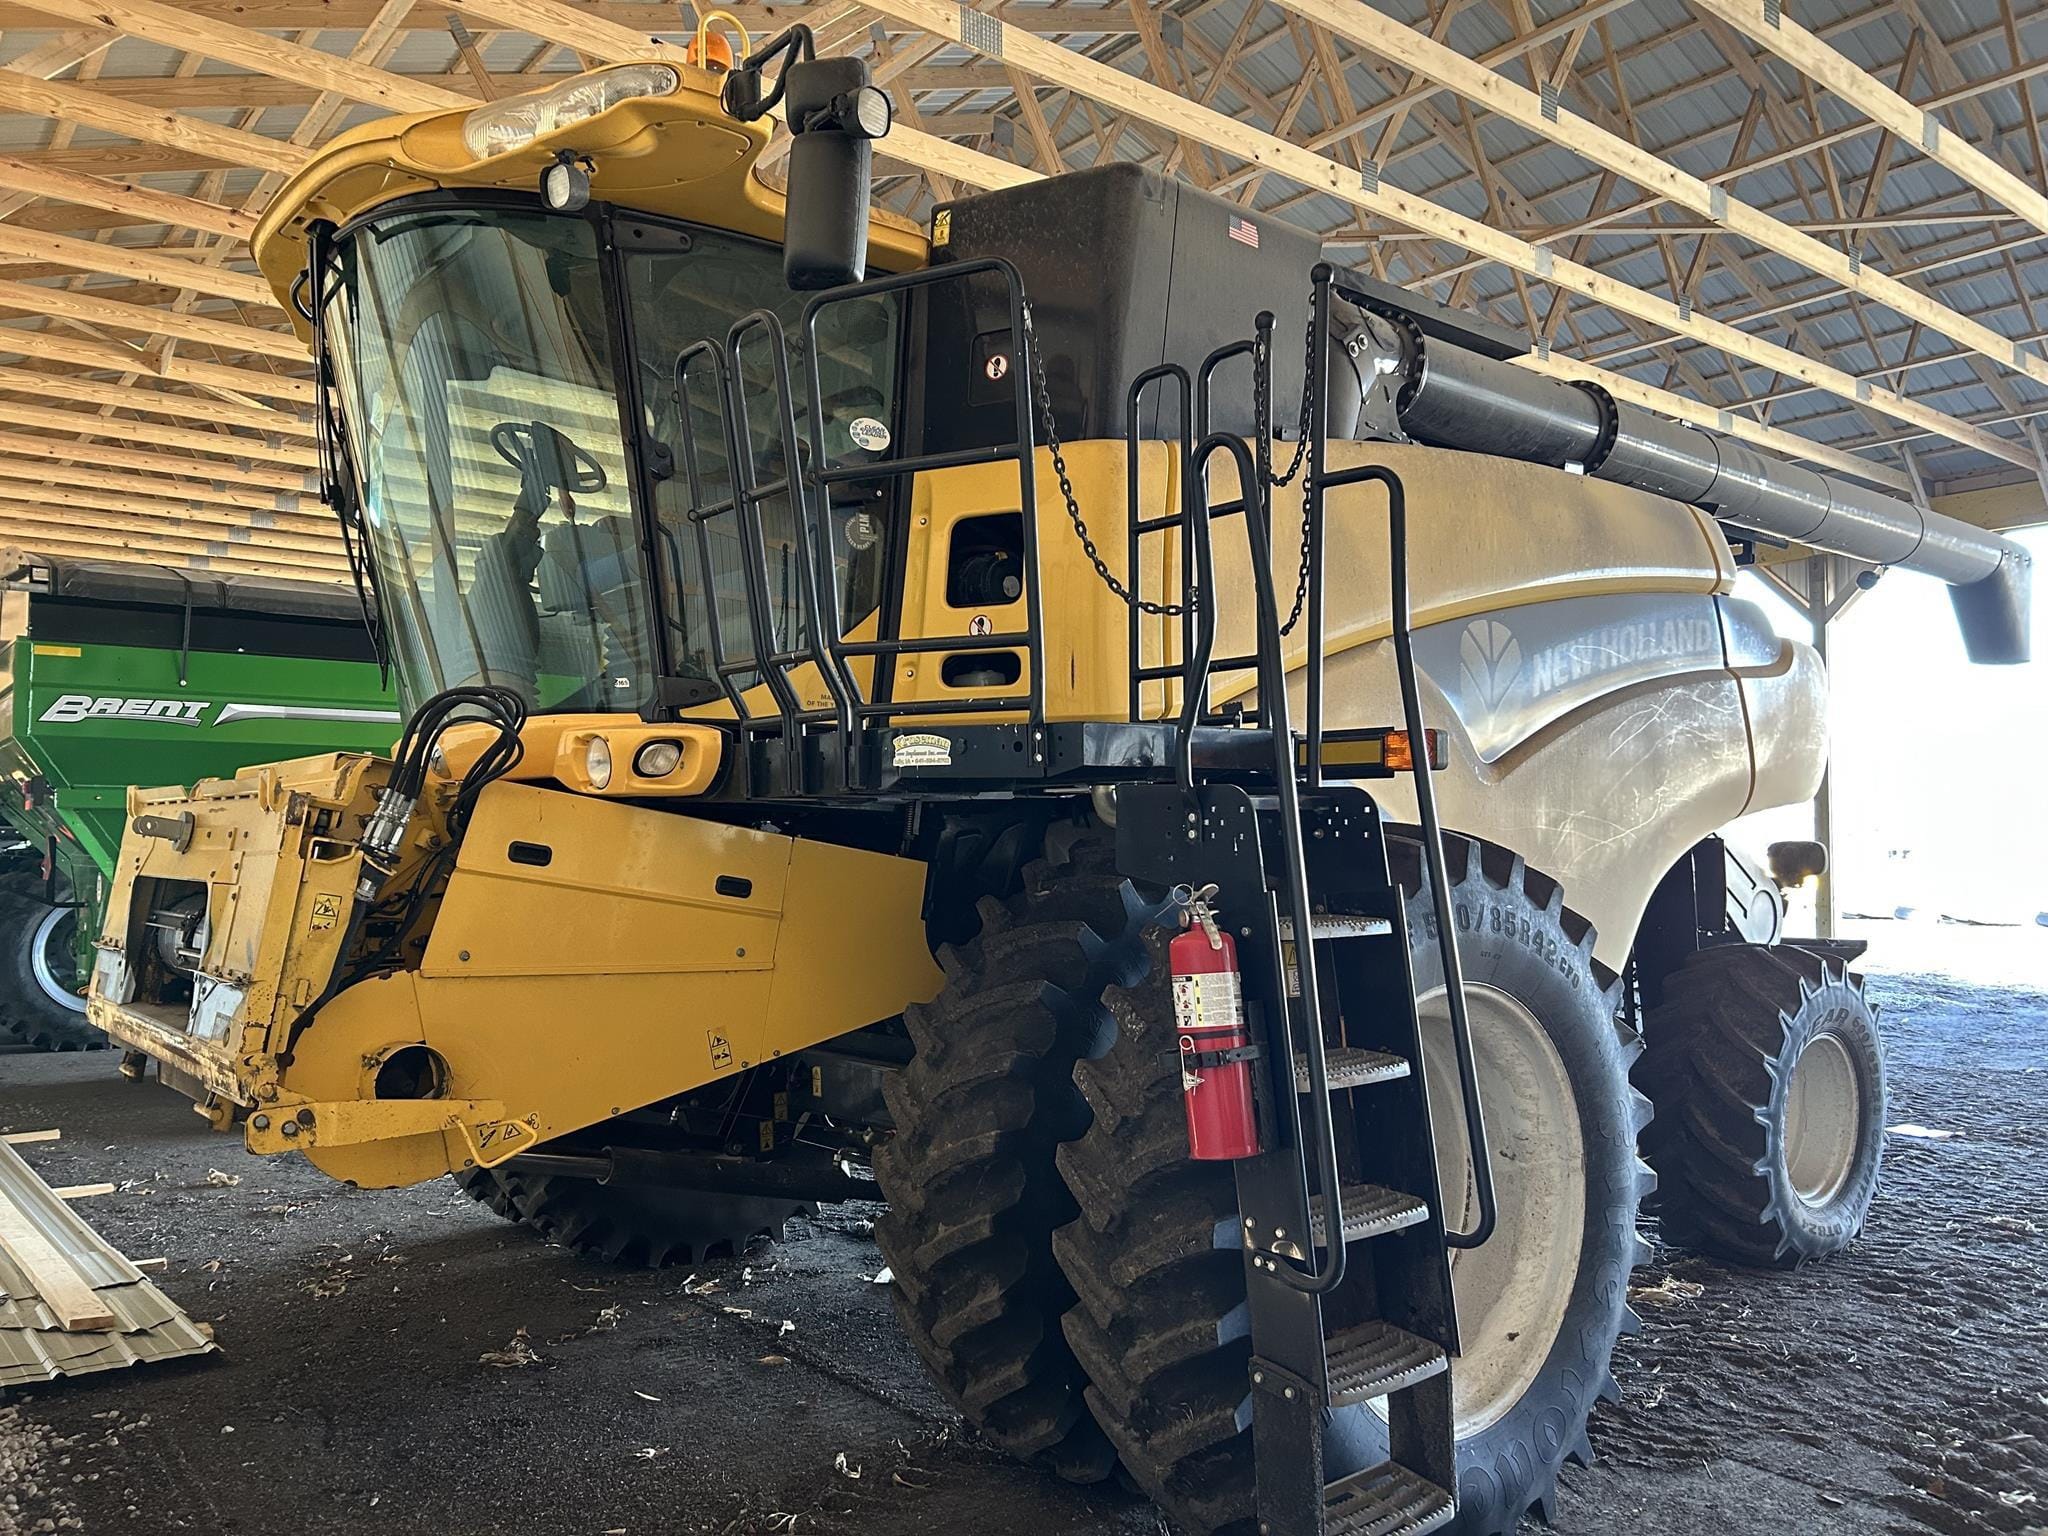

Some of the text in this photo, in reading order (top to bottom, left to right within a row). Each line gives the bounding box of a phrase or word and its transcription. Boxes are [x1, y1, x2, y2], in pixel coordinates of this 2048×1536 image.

[858, 513, 870, 534] PLM
[1532, 618, 1713, 698] NEW HOLLAND
[38, 694, 211, 723] BRENT
[1422, 902, 1557, 969] 50/85R42
